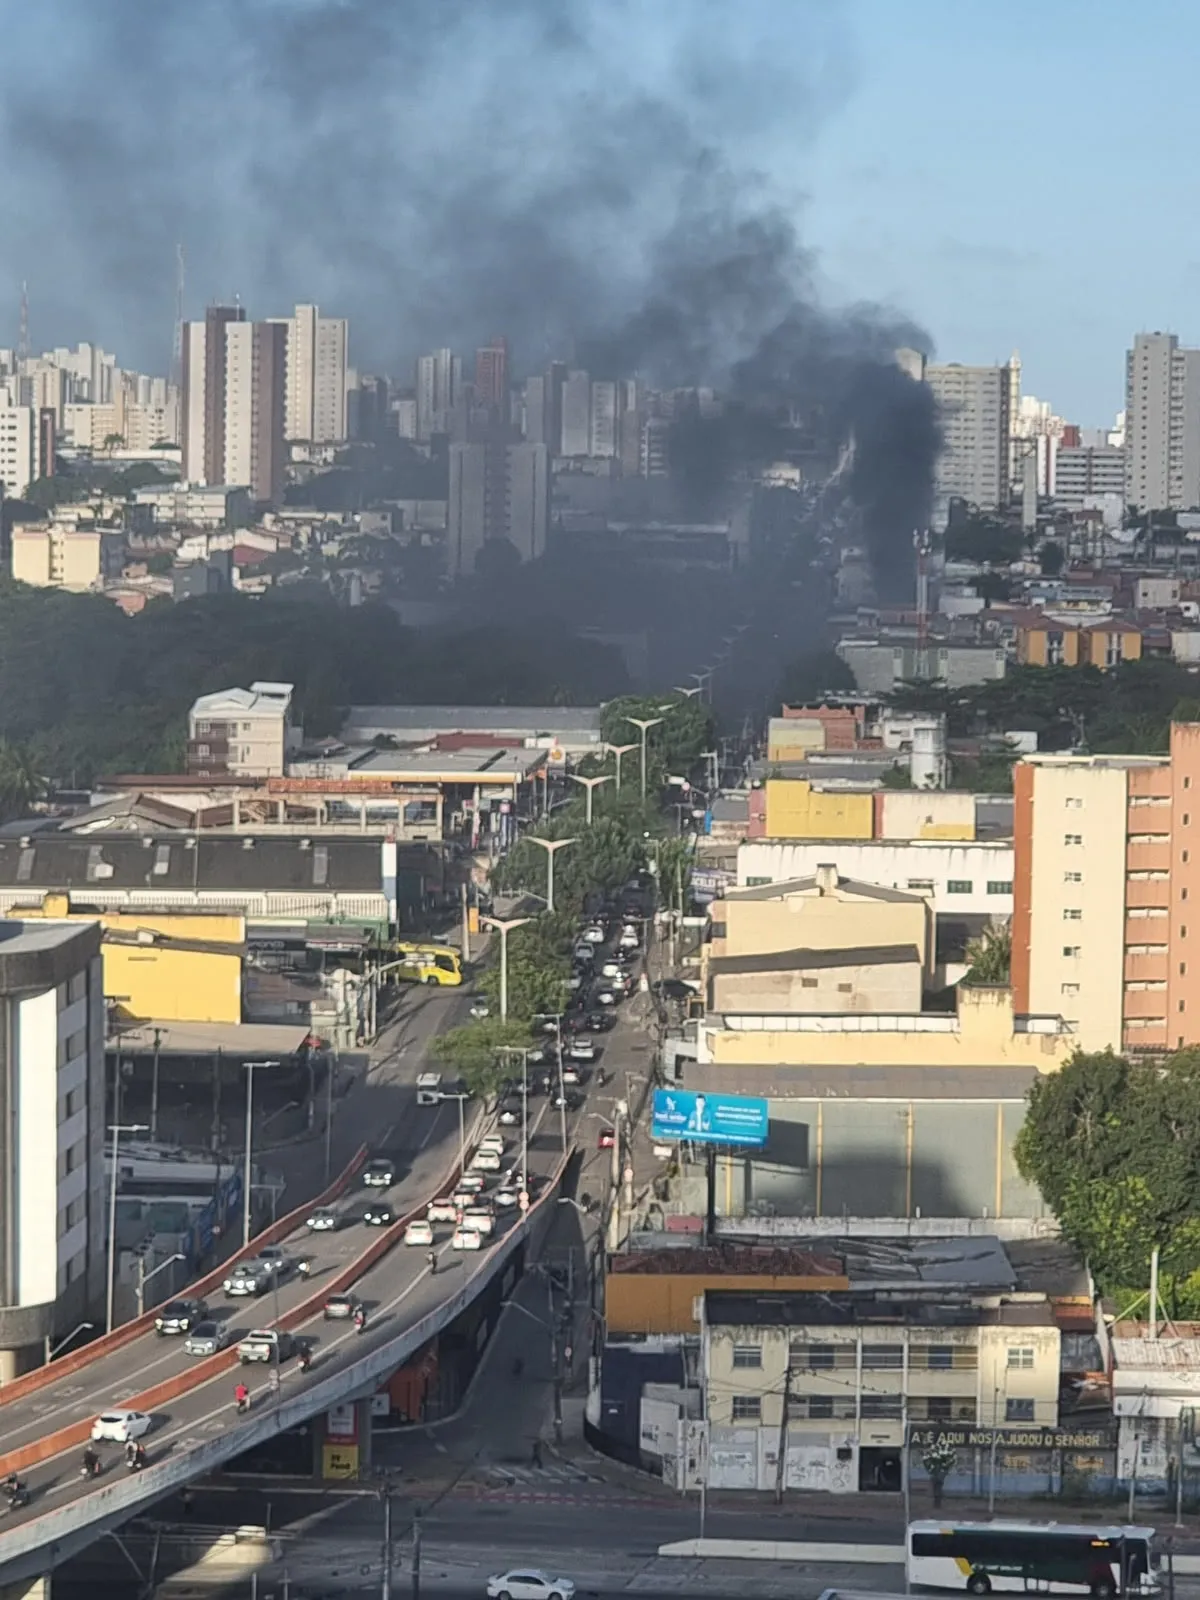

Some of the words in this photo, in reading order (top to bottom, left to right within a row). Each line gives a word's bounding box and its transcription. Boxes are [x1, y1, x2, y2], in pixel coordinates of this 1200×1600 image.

[936, 1432, 965, 1444] AQUI
[968, 1432, 993, 1445] NOS
[1044, 1433, 1053, 1446] O
[1055, 1434, 1100, 1447] SENHOR
